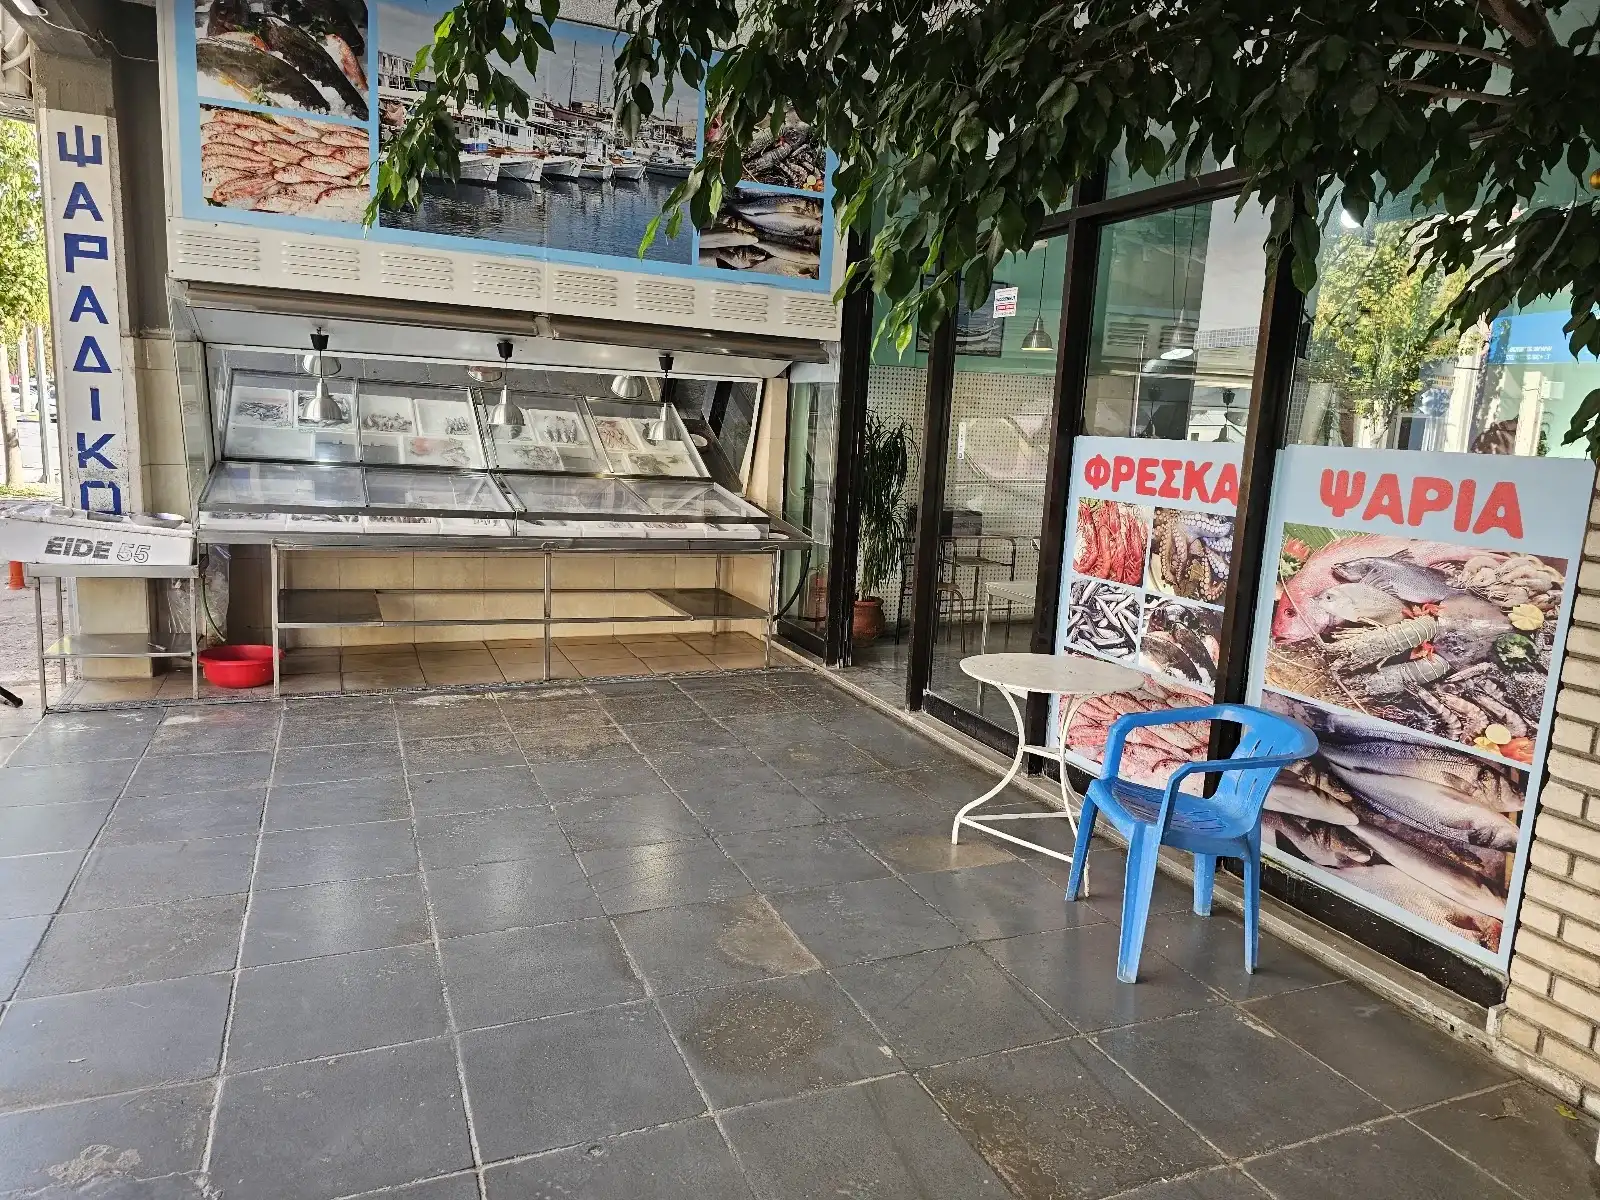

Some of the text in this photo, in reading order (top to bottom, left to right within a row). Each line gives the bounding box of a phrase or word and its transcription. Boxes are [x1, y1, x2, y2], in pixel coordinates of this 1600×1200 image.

[57, 125, 122, 515] ΨΑΡΑΔΙΚΟ
[1084, 454, 1239, 506] ΦΡΕΣΚΑ
[1320, 469, 1524, 539] ΨΑΡΙΑ
[44, 536, 151, 563] EIDE 55
